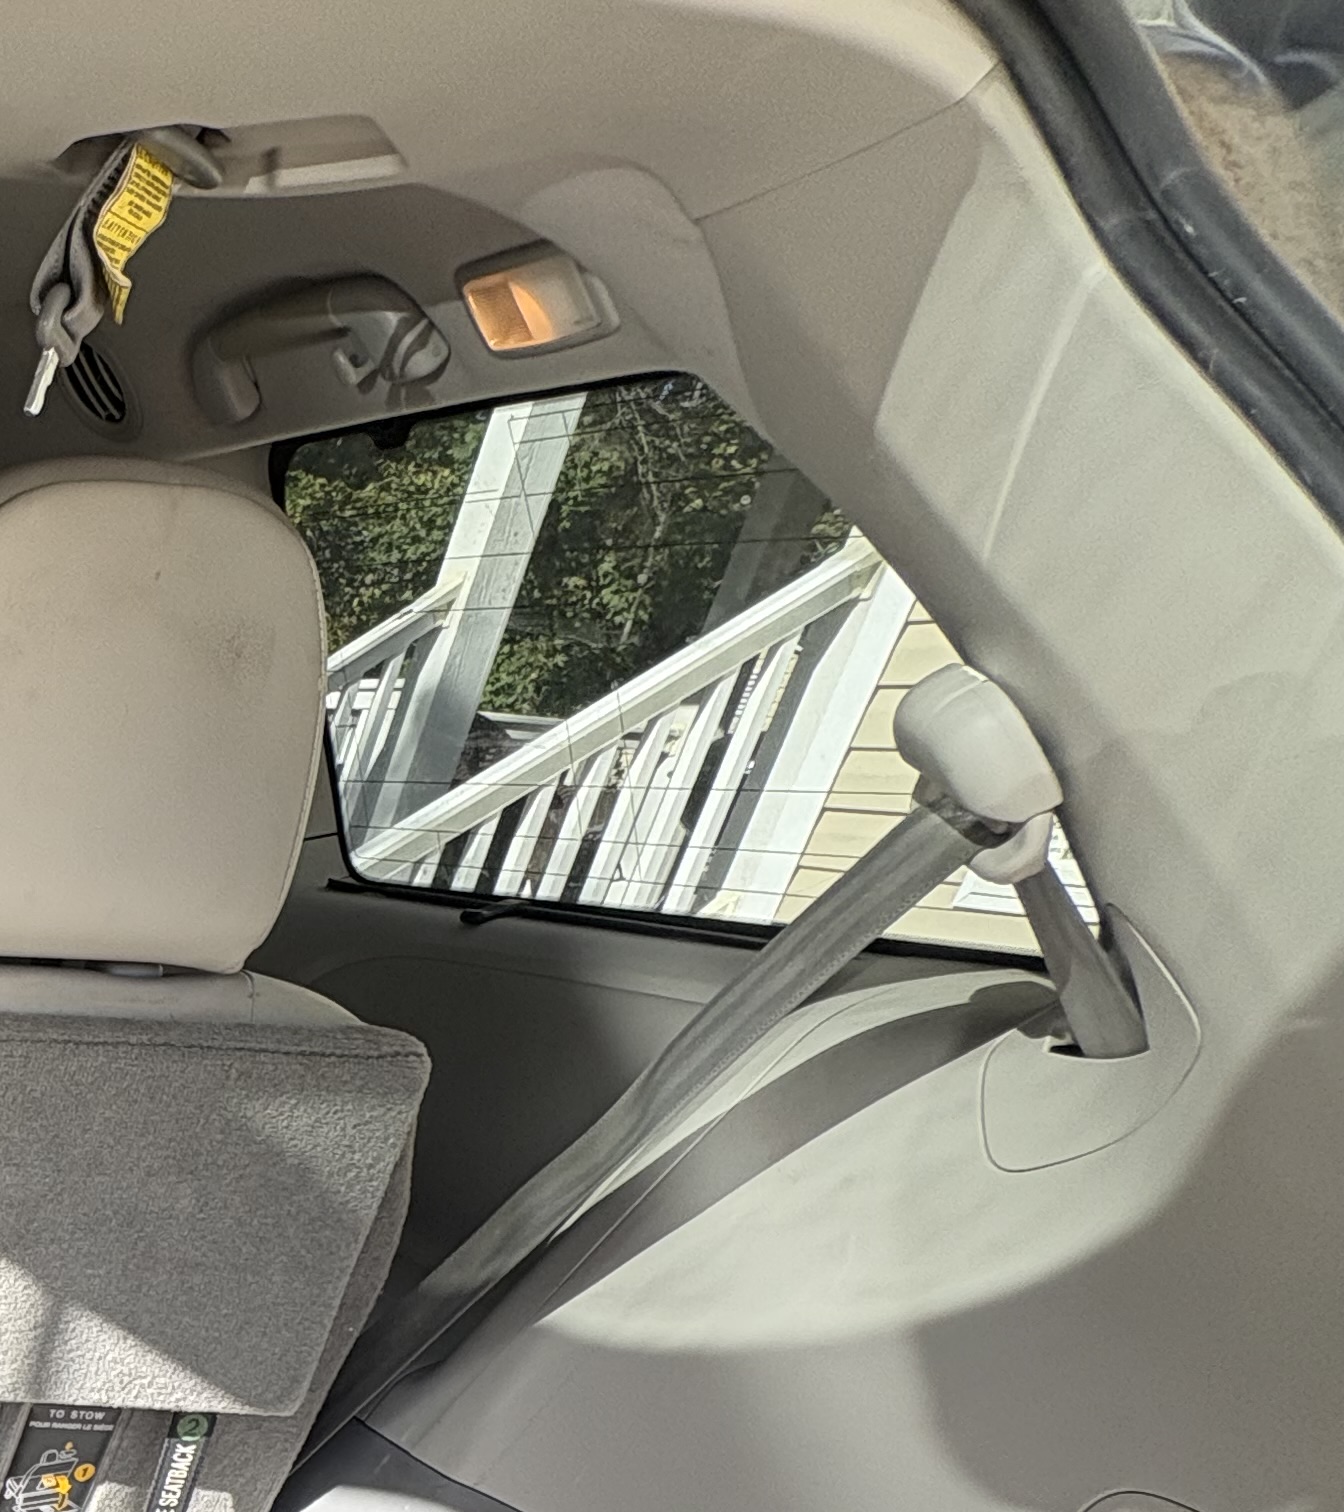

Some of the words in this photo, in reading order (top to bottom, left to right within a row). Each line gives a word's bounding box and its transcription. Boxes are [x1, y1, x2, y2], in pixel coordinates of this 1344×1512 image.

[49, 1409, 65, 1419] TO
[70, 1409, 106, 1420] STOW
[159, 1443, 197, 1508] SEATBACK
